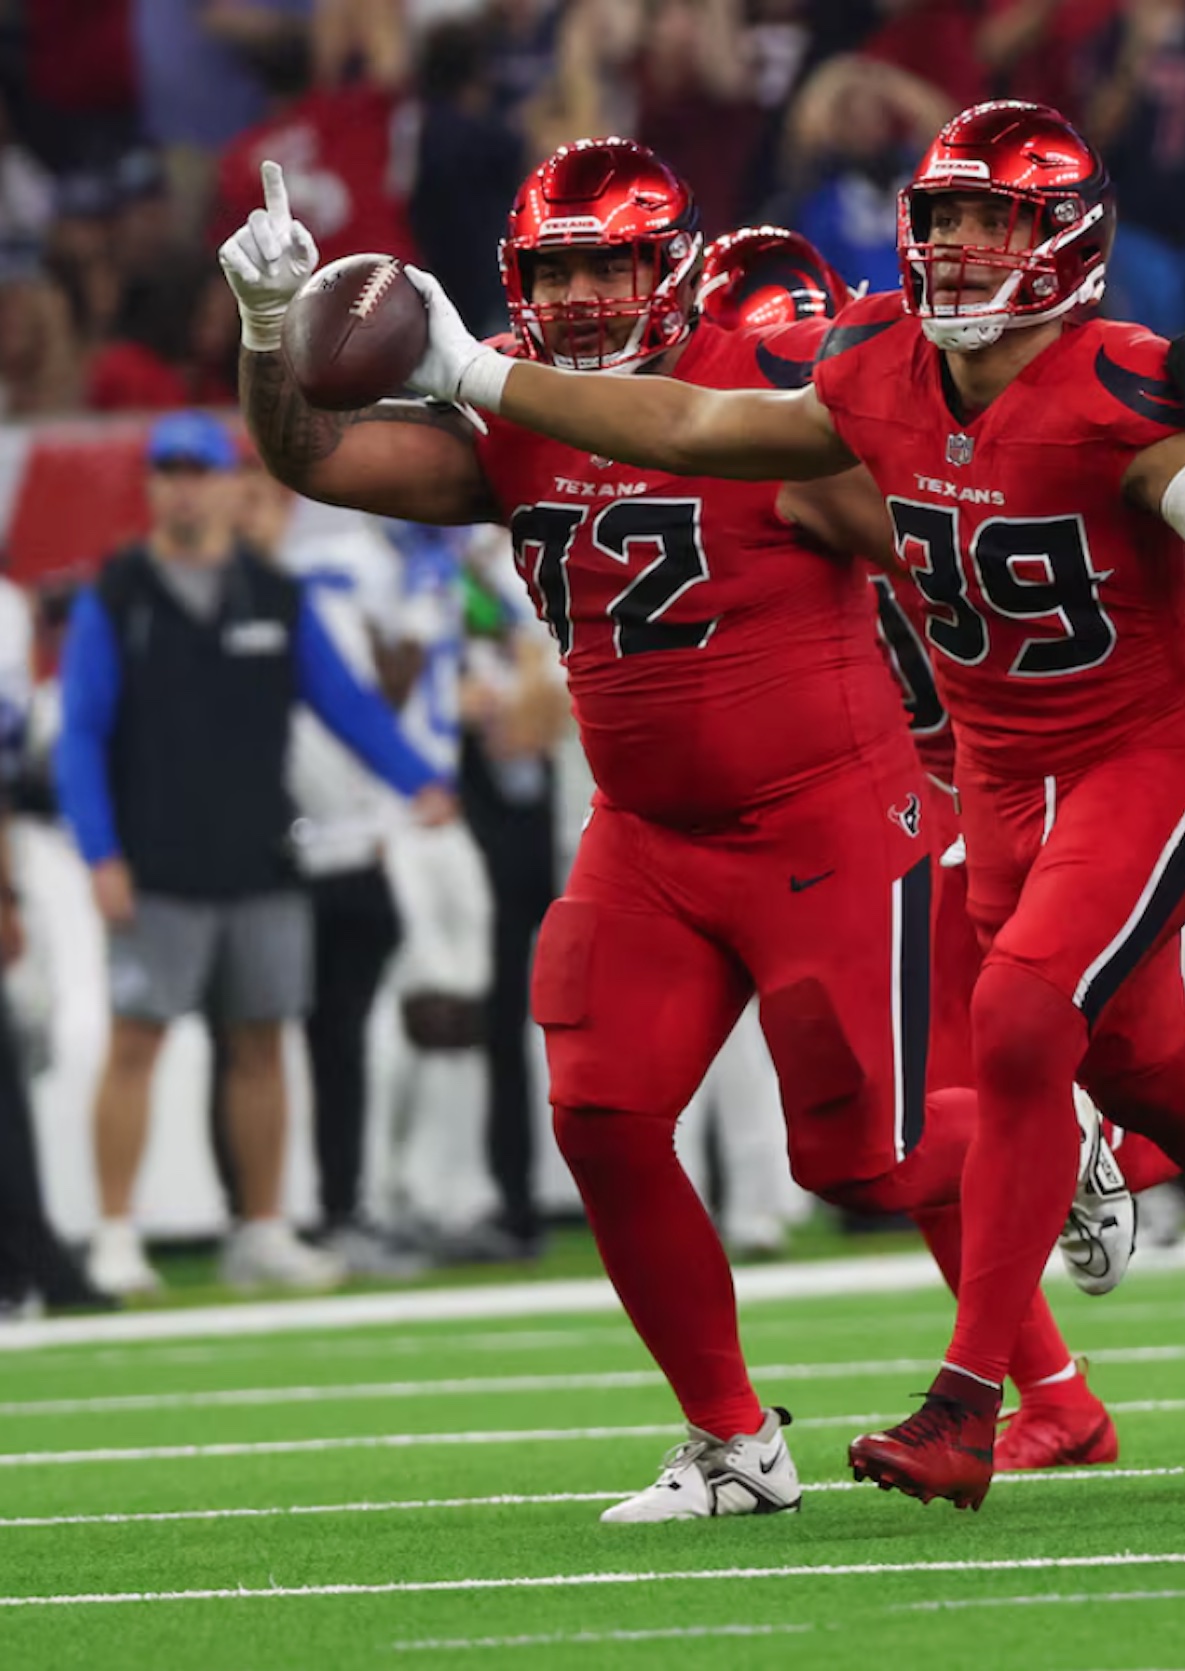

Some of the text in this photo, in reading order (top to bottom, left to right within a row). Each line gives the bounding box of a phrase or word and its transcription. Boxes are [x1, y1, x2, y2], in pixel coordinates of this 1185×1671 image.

[545, 221, 594, 229] TEXANS
[554, 476, 648, 496] TEXANS
[914, 473, 1005, 506] TEXANS
[511, 497, 724, 660] 72
[887, 495, 1117, 677] 39
